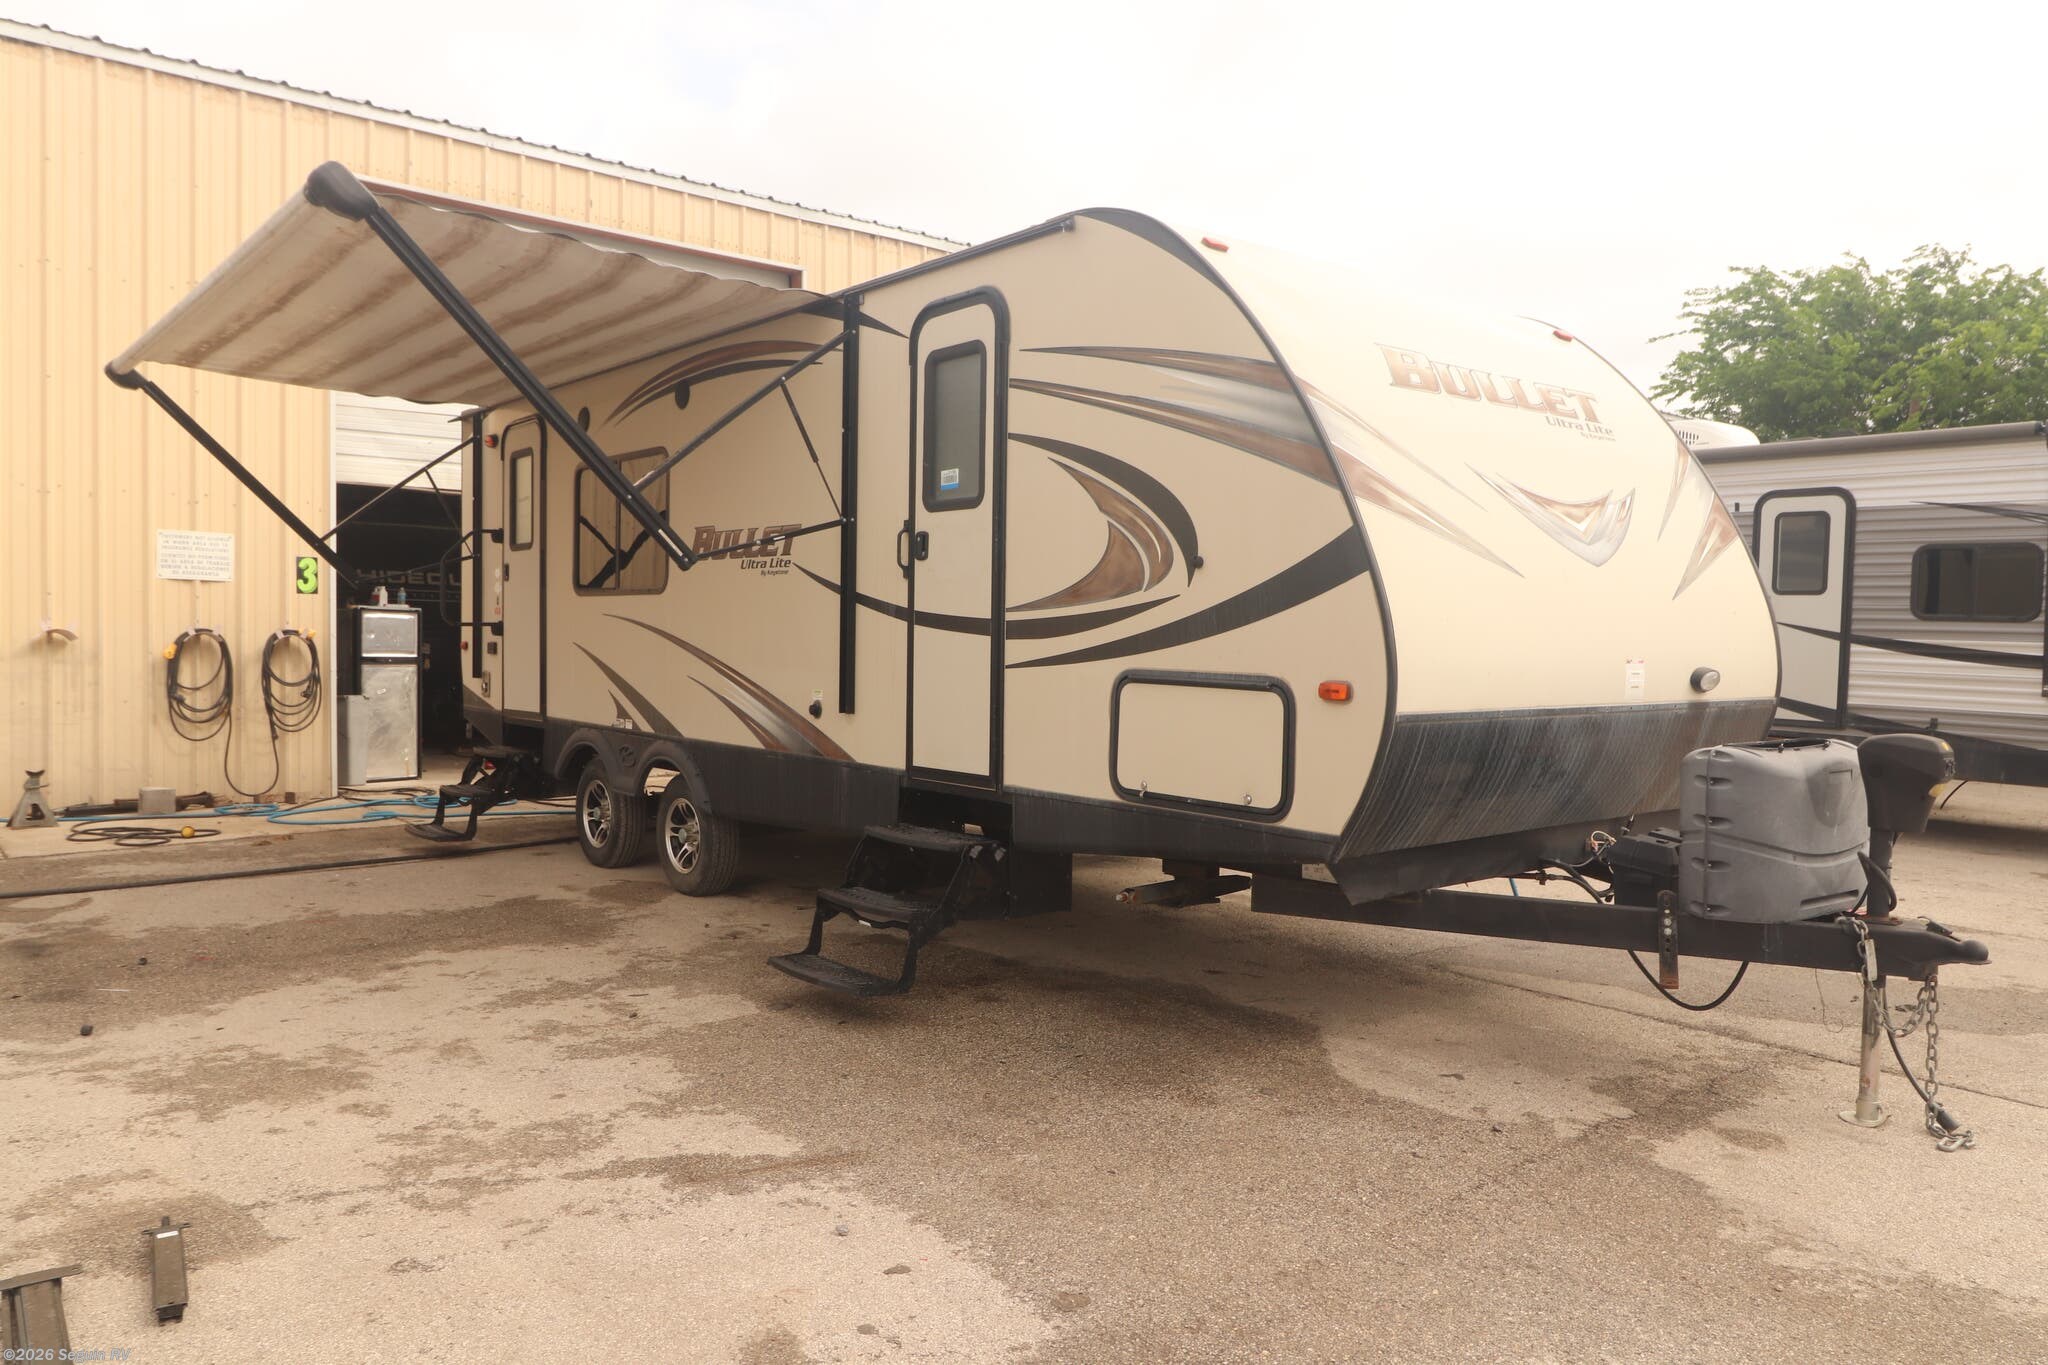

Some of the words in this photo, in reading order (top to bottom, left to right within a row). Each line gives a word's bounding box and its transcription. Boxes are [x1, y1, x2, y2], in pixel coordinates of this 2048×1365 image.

[1376, 343, 1601, 423] BULLET
[1545, 415, 1584, 431] Ultra
[1585, 422, 1613, 436] Lite
[691, 524, 802, 560] BULLET
[298, 557, 318, 593] 3
[741, 559, 767, 569] Ultra
[769, 558, 791, 568] Lite
